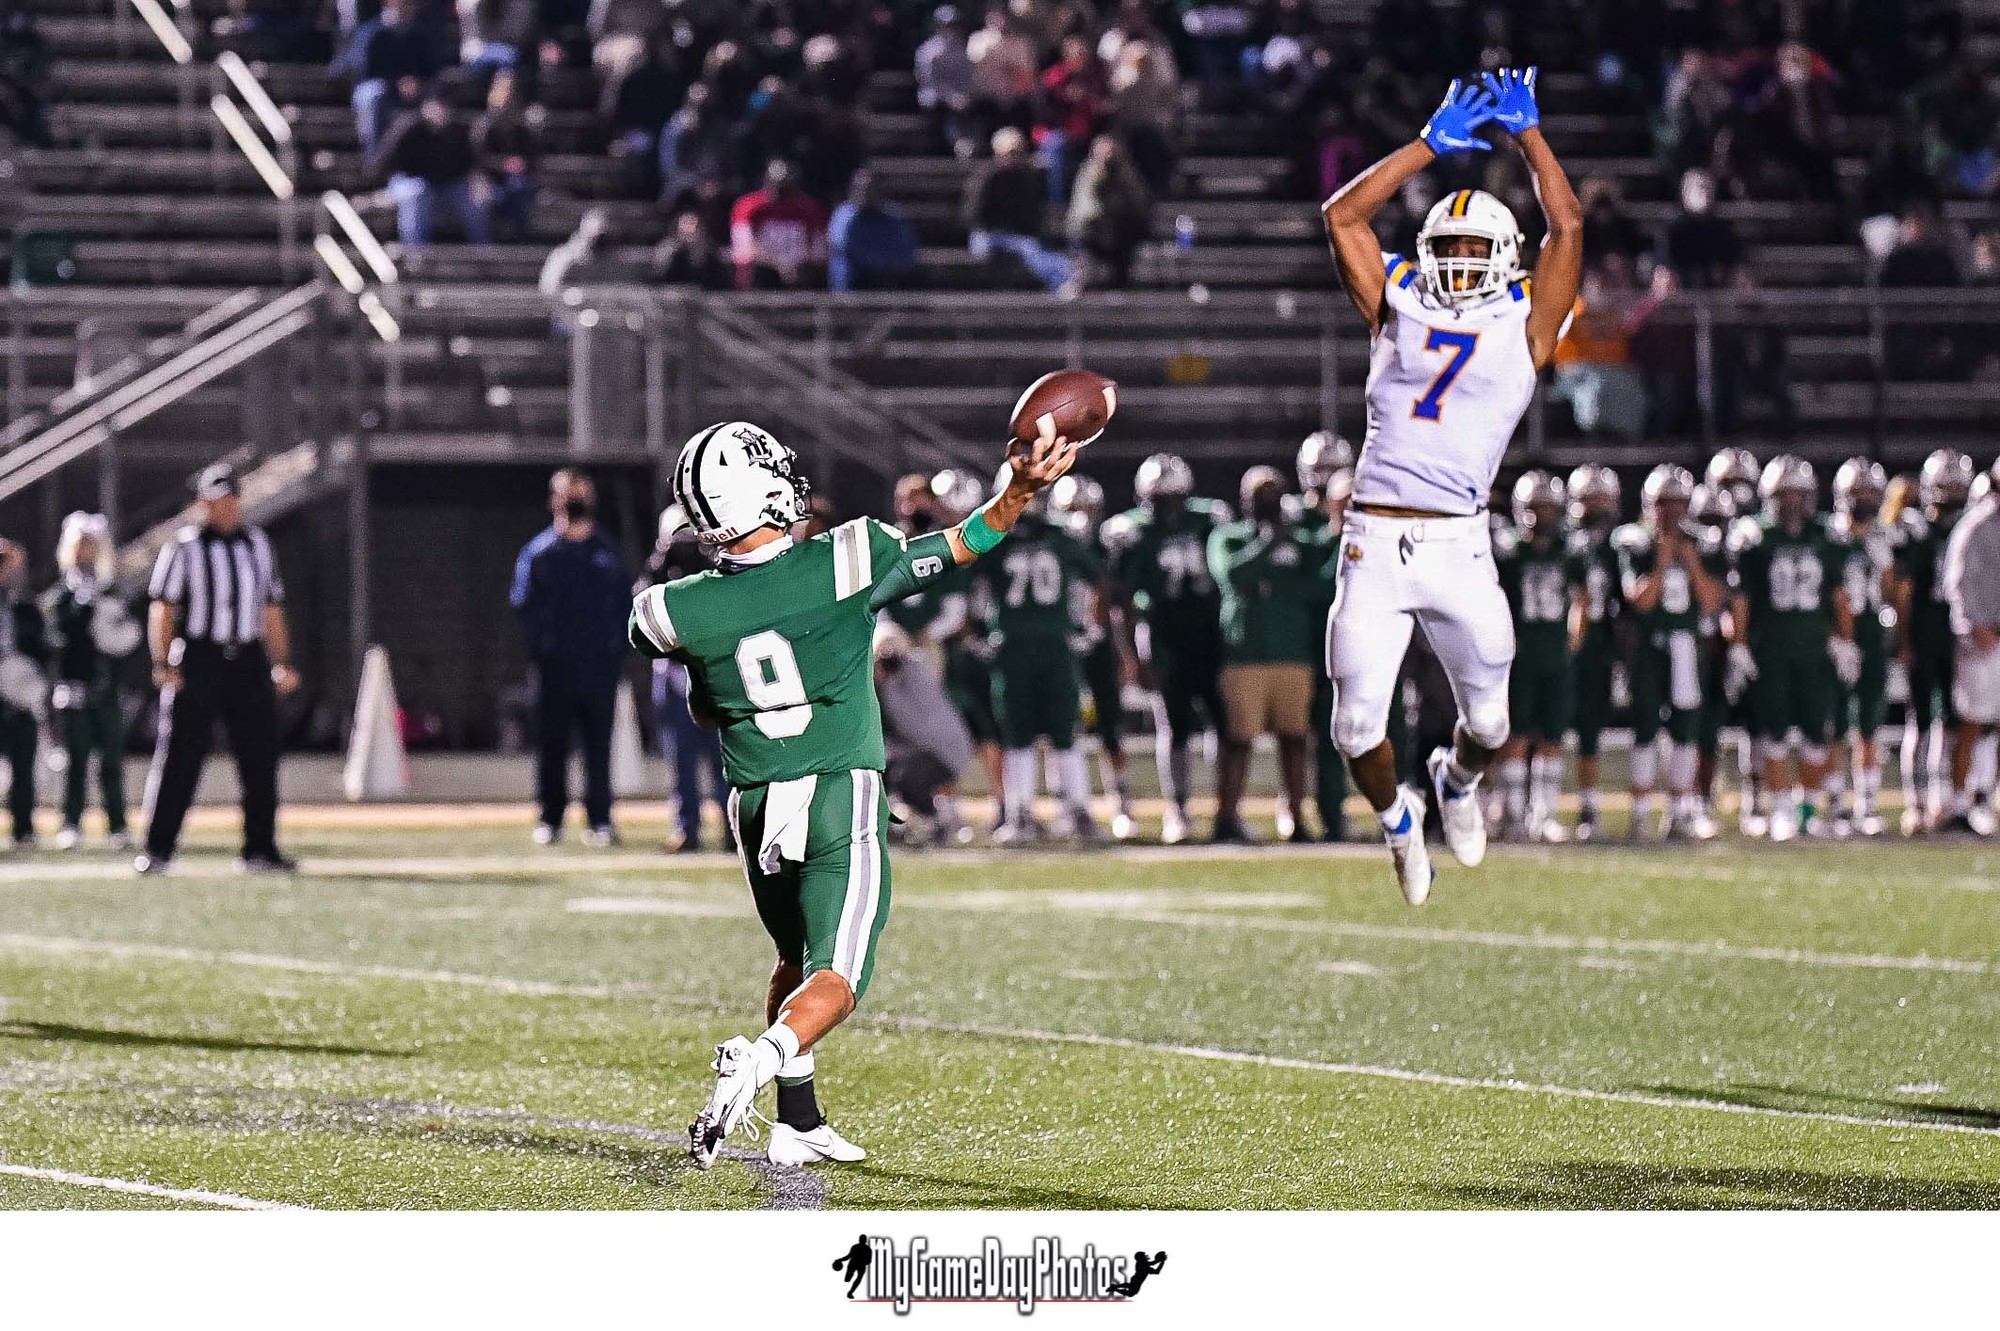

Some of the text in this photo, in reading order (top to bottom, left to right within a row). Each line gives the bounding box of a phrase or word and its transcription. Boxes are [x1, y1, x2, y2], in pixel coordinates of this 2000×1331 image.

[1410, 327, 1481, 424] 7
[1003, 547, 1061, 608] 70
[735, 629, 813, 739] 9
